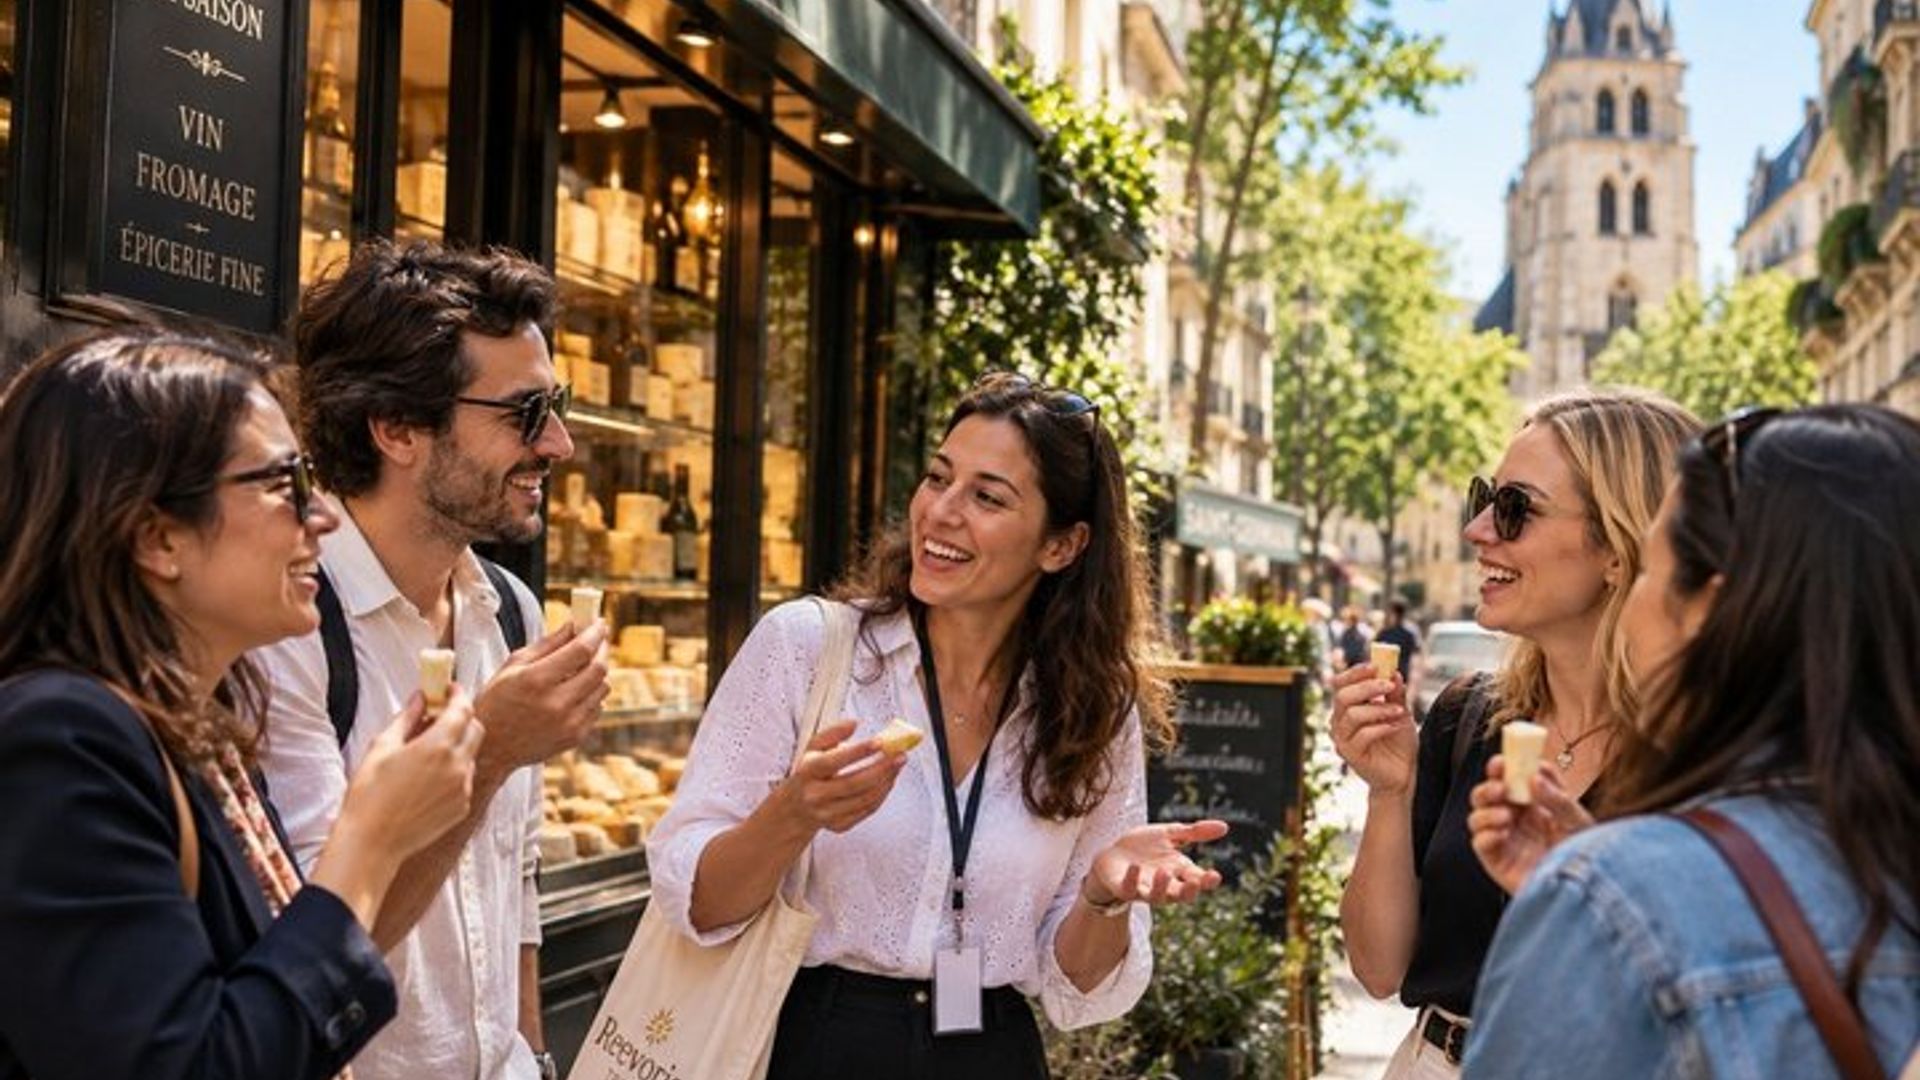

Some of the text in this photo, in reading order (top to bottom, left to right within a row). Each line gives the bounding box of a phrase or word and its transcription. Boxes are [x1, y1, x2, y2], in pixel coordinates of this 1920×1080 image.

[179, 105, 224, 150] VIN
[136, 152, 256, 221] FROMAGE
[120, 221, 265, 296] ÉPICERIE FINE
[595, 1015, 682, 1080] Reevori
